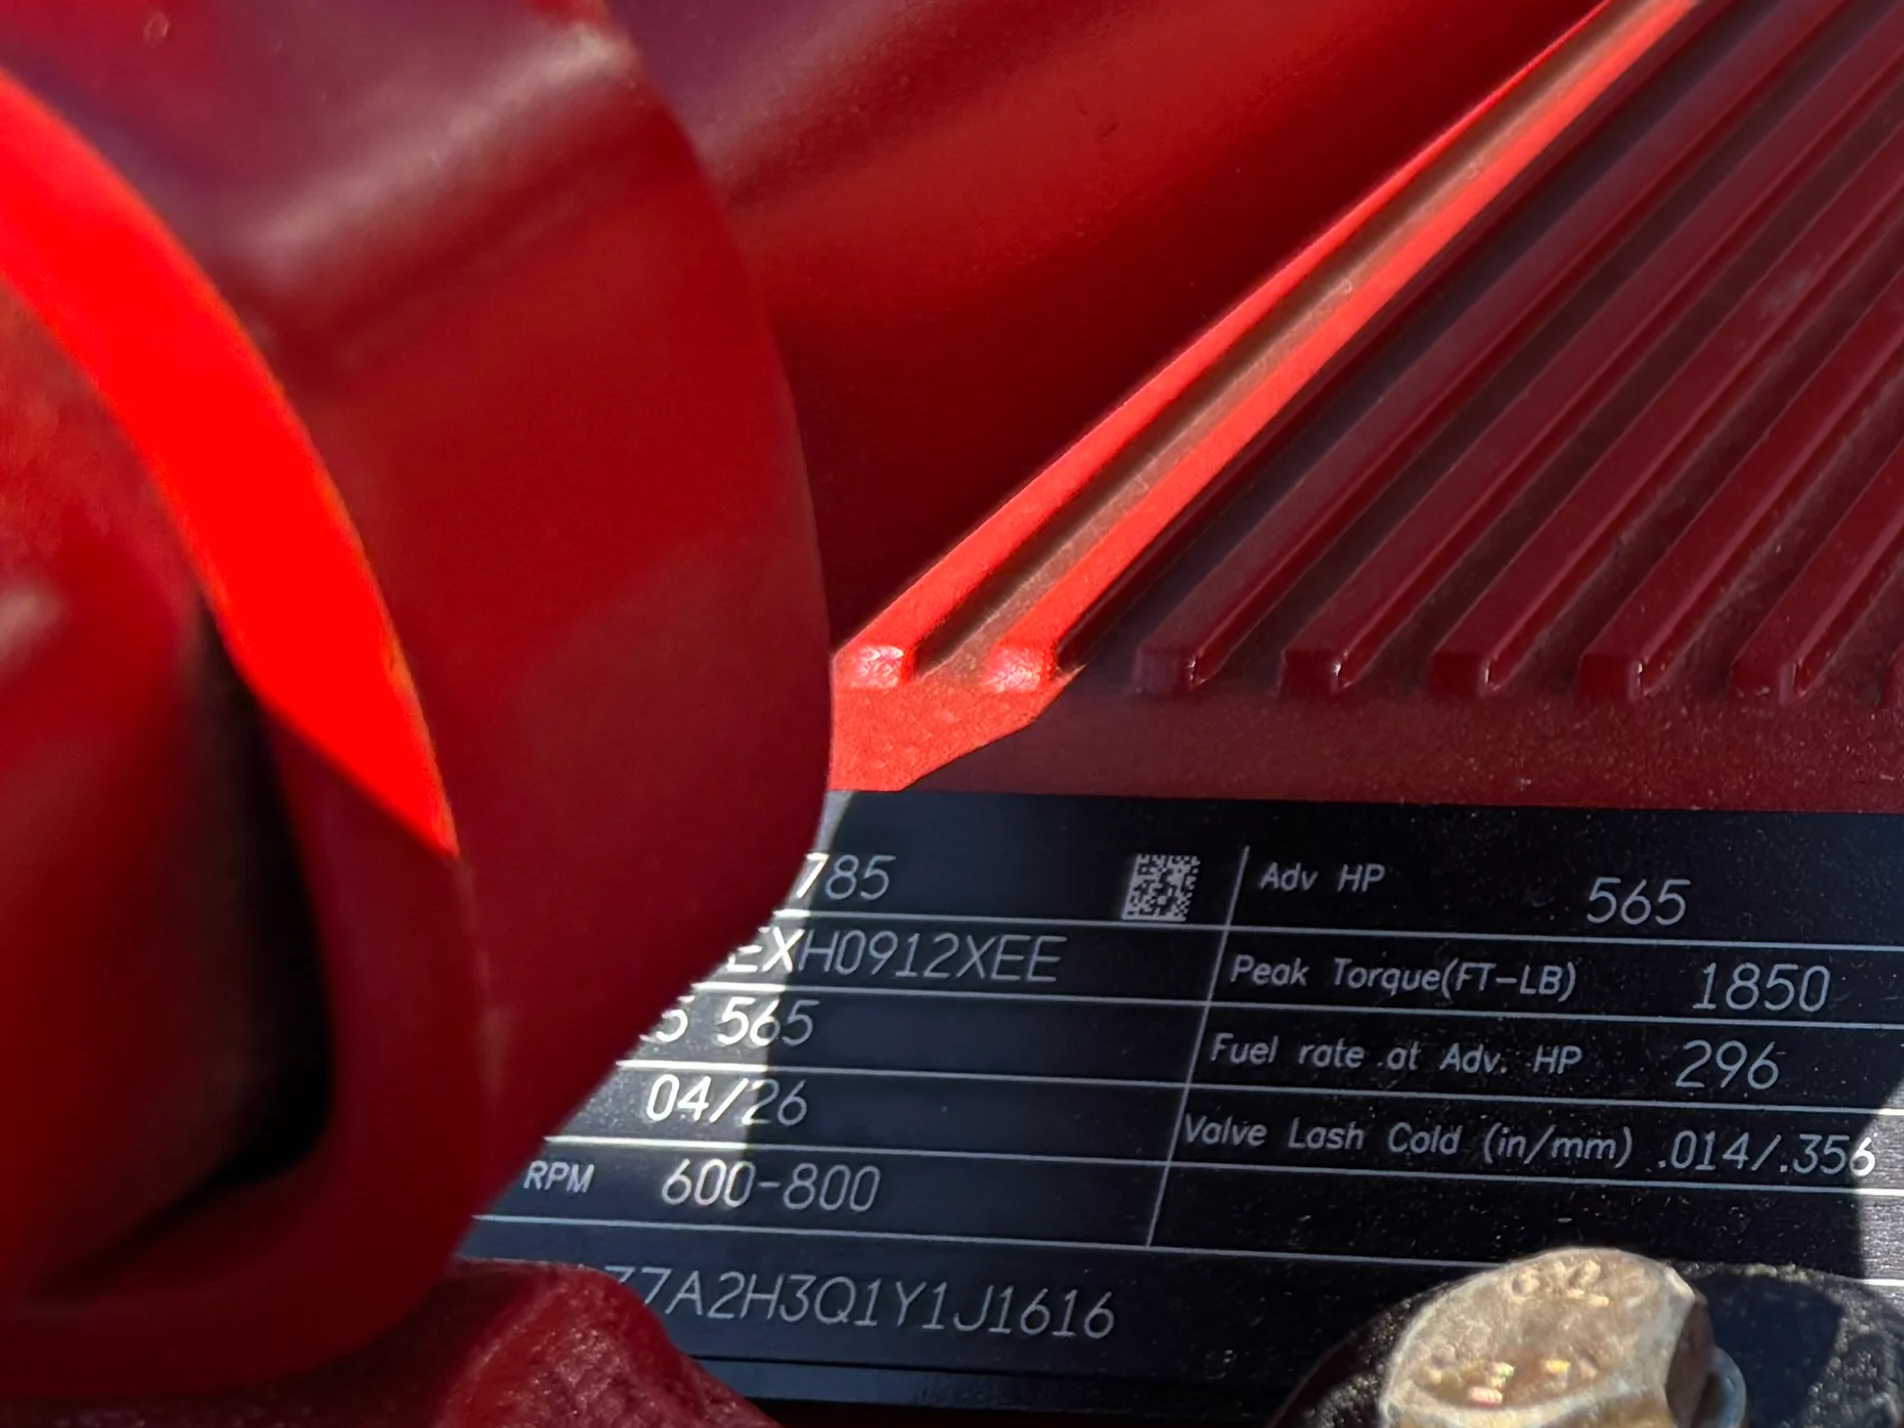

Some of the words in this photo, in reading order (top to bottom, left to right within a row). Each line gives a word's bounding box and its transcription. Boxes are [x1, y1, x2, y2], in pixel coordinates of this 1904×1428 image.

[796, 852, 897, 900] 785
[1259, 863, 1318, 891] Adv
[1338, 865, 1386, 892] HP
[1585, 876, 1692, 927] 565
[1230, 954, 1308, 988] Peak
[1332, 957, 1577, 1003] Torque(FT-LB)
[1691, 962, 1831, 1013] 1850
[715, 995, 820, 1047] 565
[1208, 1032, 1279, 1065] Fuel
[1298, 1038, 1365, 1070] rate
[1386, 1040, 1421, 1071] at
[1439, 1043, 1509, 1075] Adv.
[1532, 1045, 1583, 1074] HP
[1674, 1038, 1781, 1091] 296
[644, 1072, 809, 1128] 04/26
[1182, 1115, 1267, 1149] Valve
[1287, 1117, 1364, 1152] Lash
[1387, 1123, 1460, 1157] Cold
[1483, 1123, 1633, 1166] (in/mm)
[1657, 1130, 1877, 1176] .014/.356
[523, 1160, 594, 1194] RPM
[661, 1157, 881, 1213] 600-800
